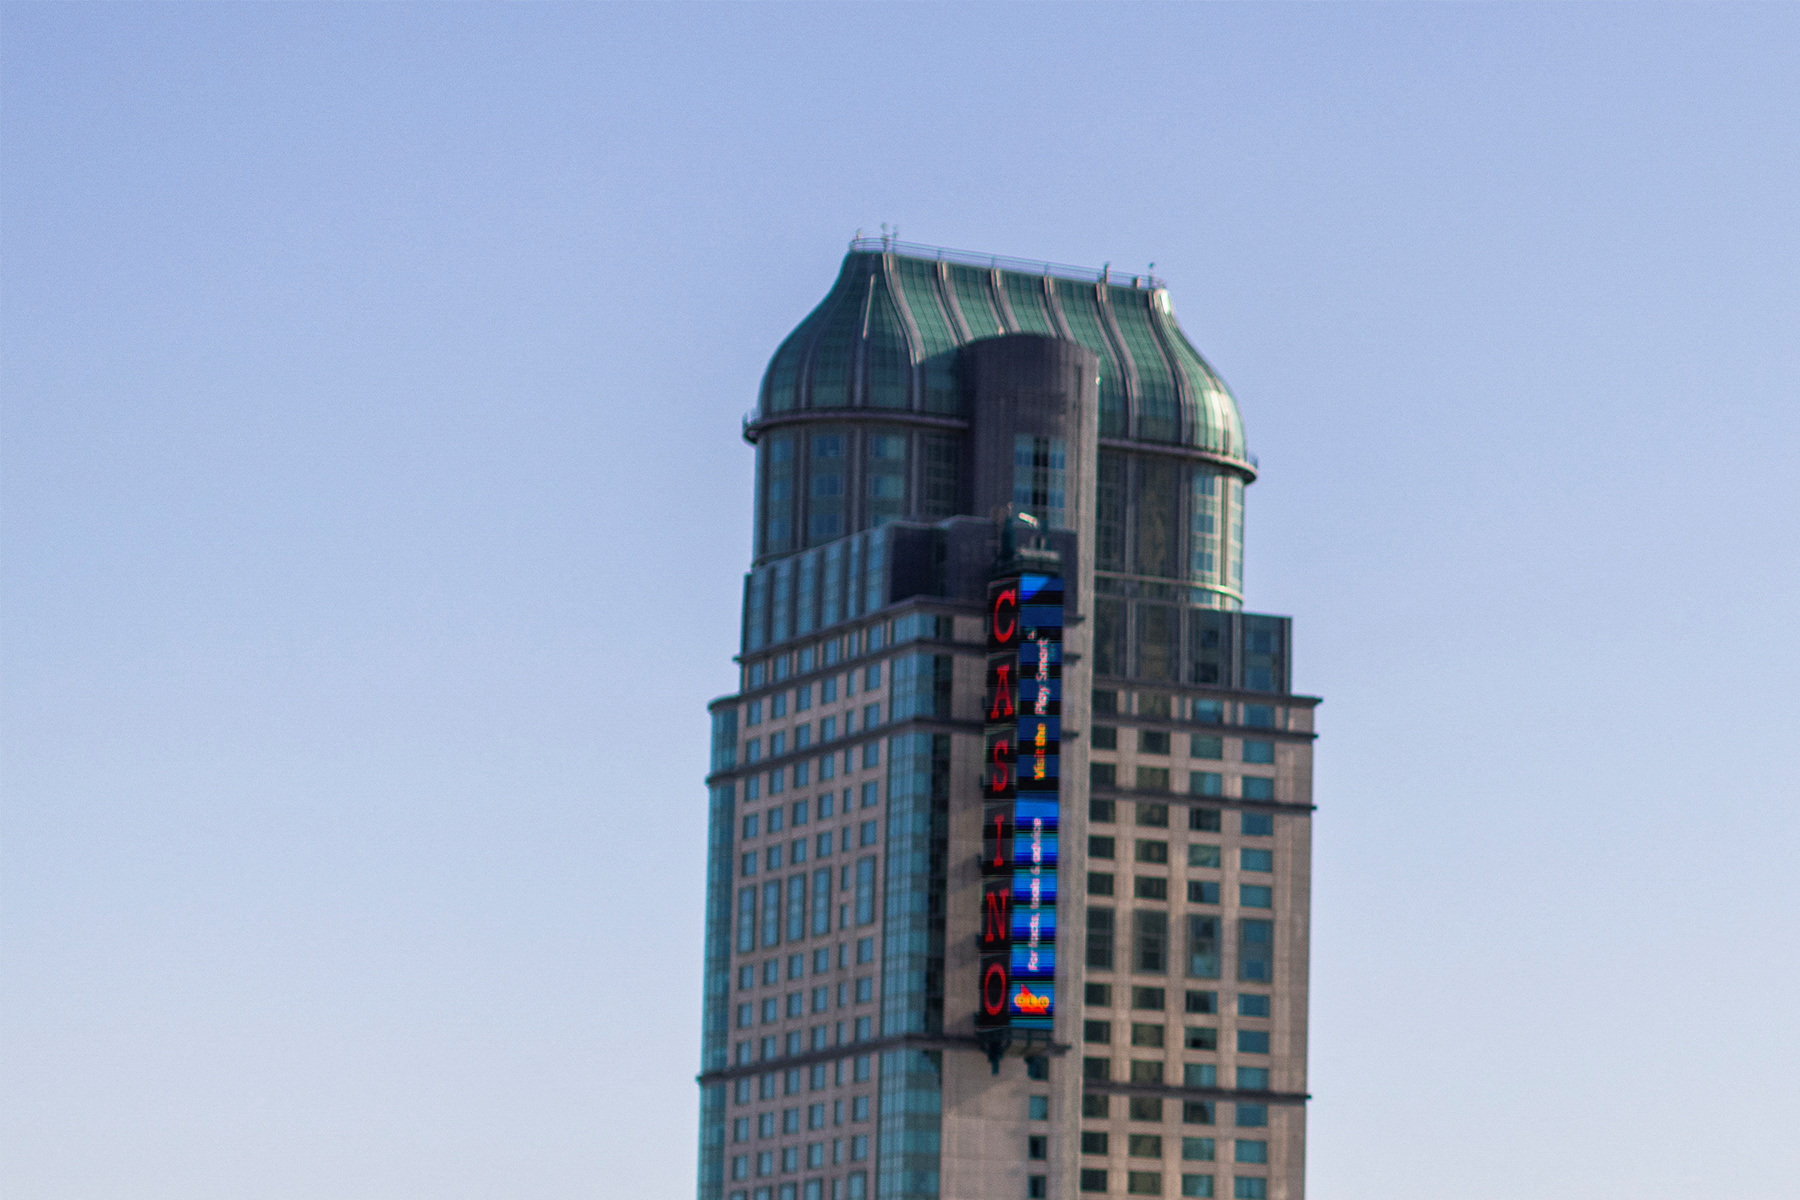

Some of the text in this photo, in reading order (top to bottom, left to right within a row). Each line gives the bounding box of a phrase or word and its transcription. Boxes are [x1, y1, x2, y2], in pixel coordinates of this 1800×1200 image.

[1035, 723, 1047, 747] the
[1034, 748, 1046, 780] Visit
[983, 588, 1017, 1016] CASINO
[1031, 818, 1042, 863] advice
[1028, 954, 1039, 972] For
